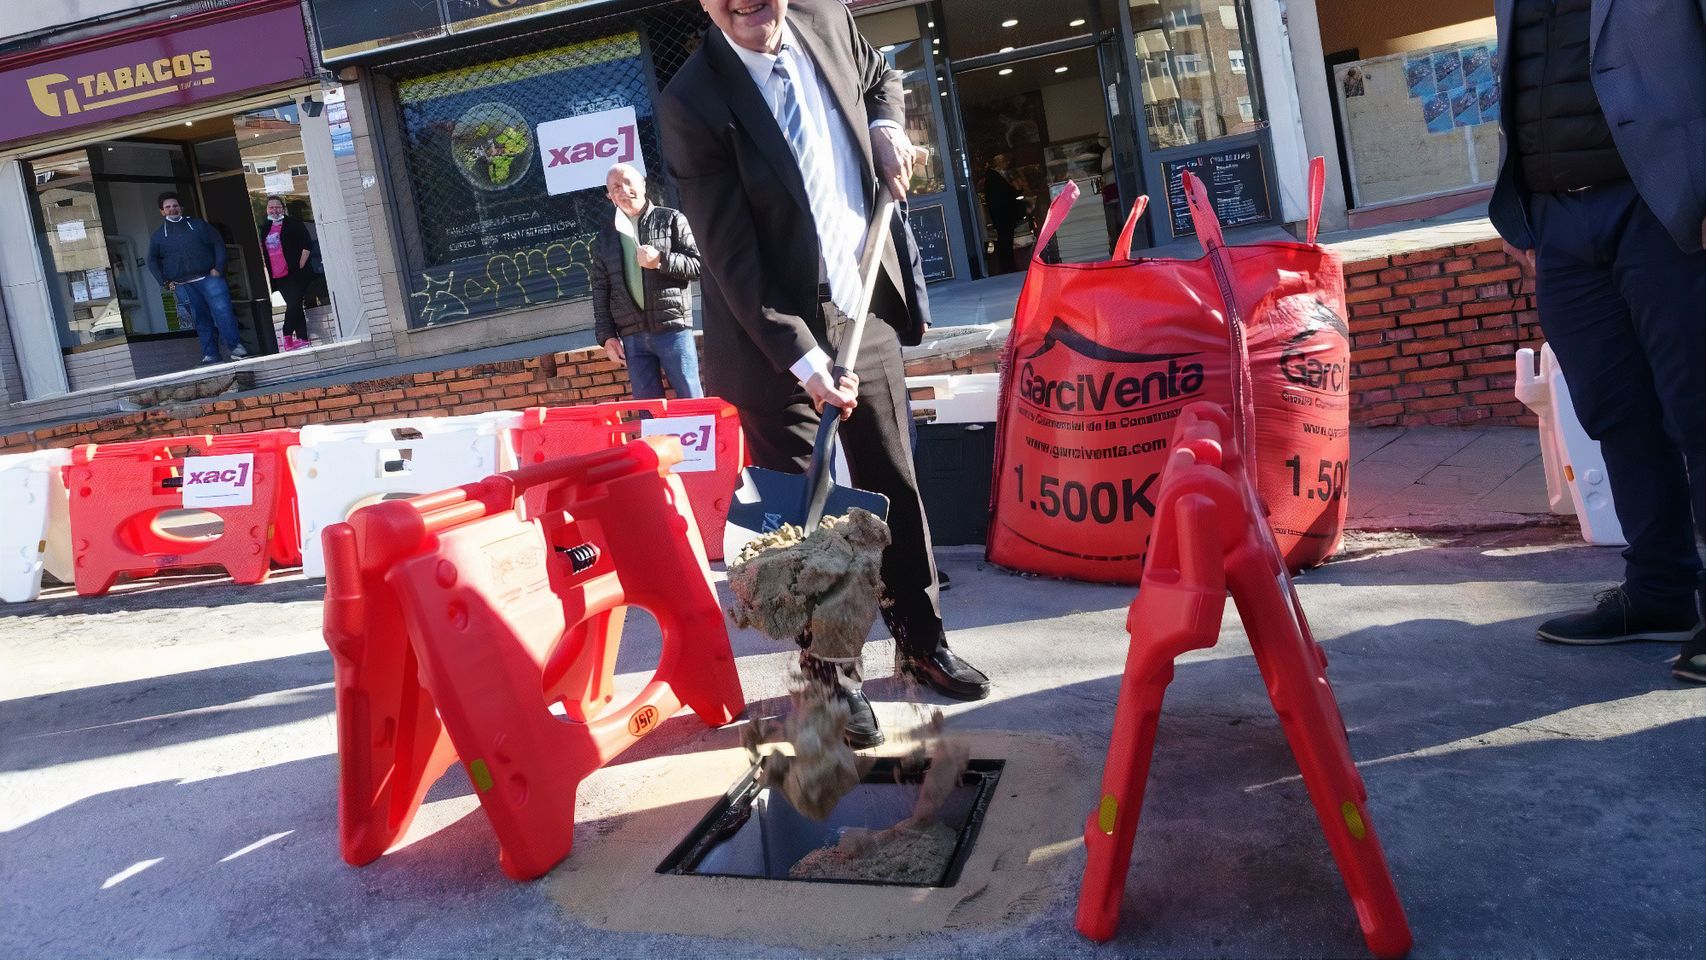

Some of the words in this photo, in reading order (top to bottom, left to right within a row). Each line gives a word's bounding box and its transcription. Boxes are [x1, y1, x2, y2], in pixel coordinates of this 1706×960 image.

[77, 49, 213, 98] TABACOS
[1020, 360, 1205, 412] GarciVenta
[1280, 350, 1348, 392] Garci
[634, 708, 654, 734] JSP
